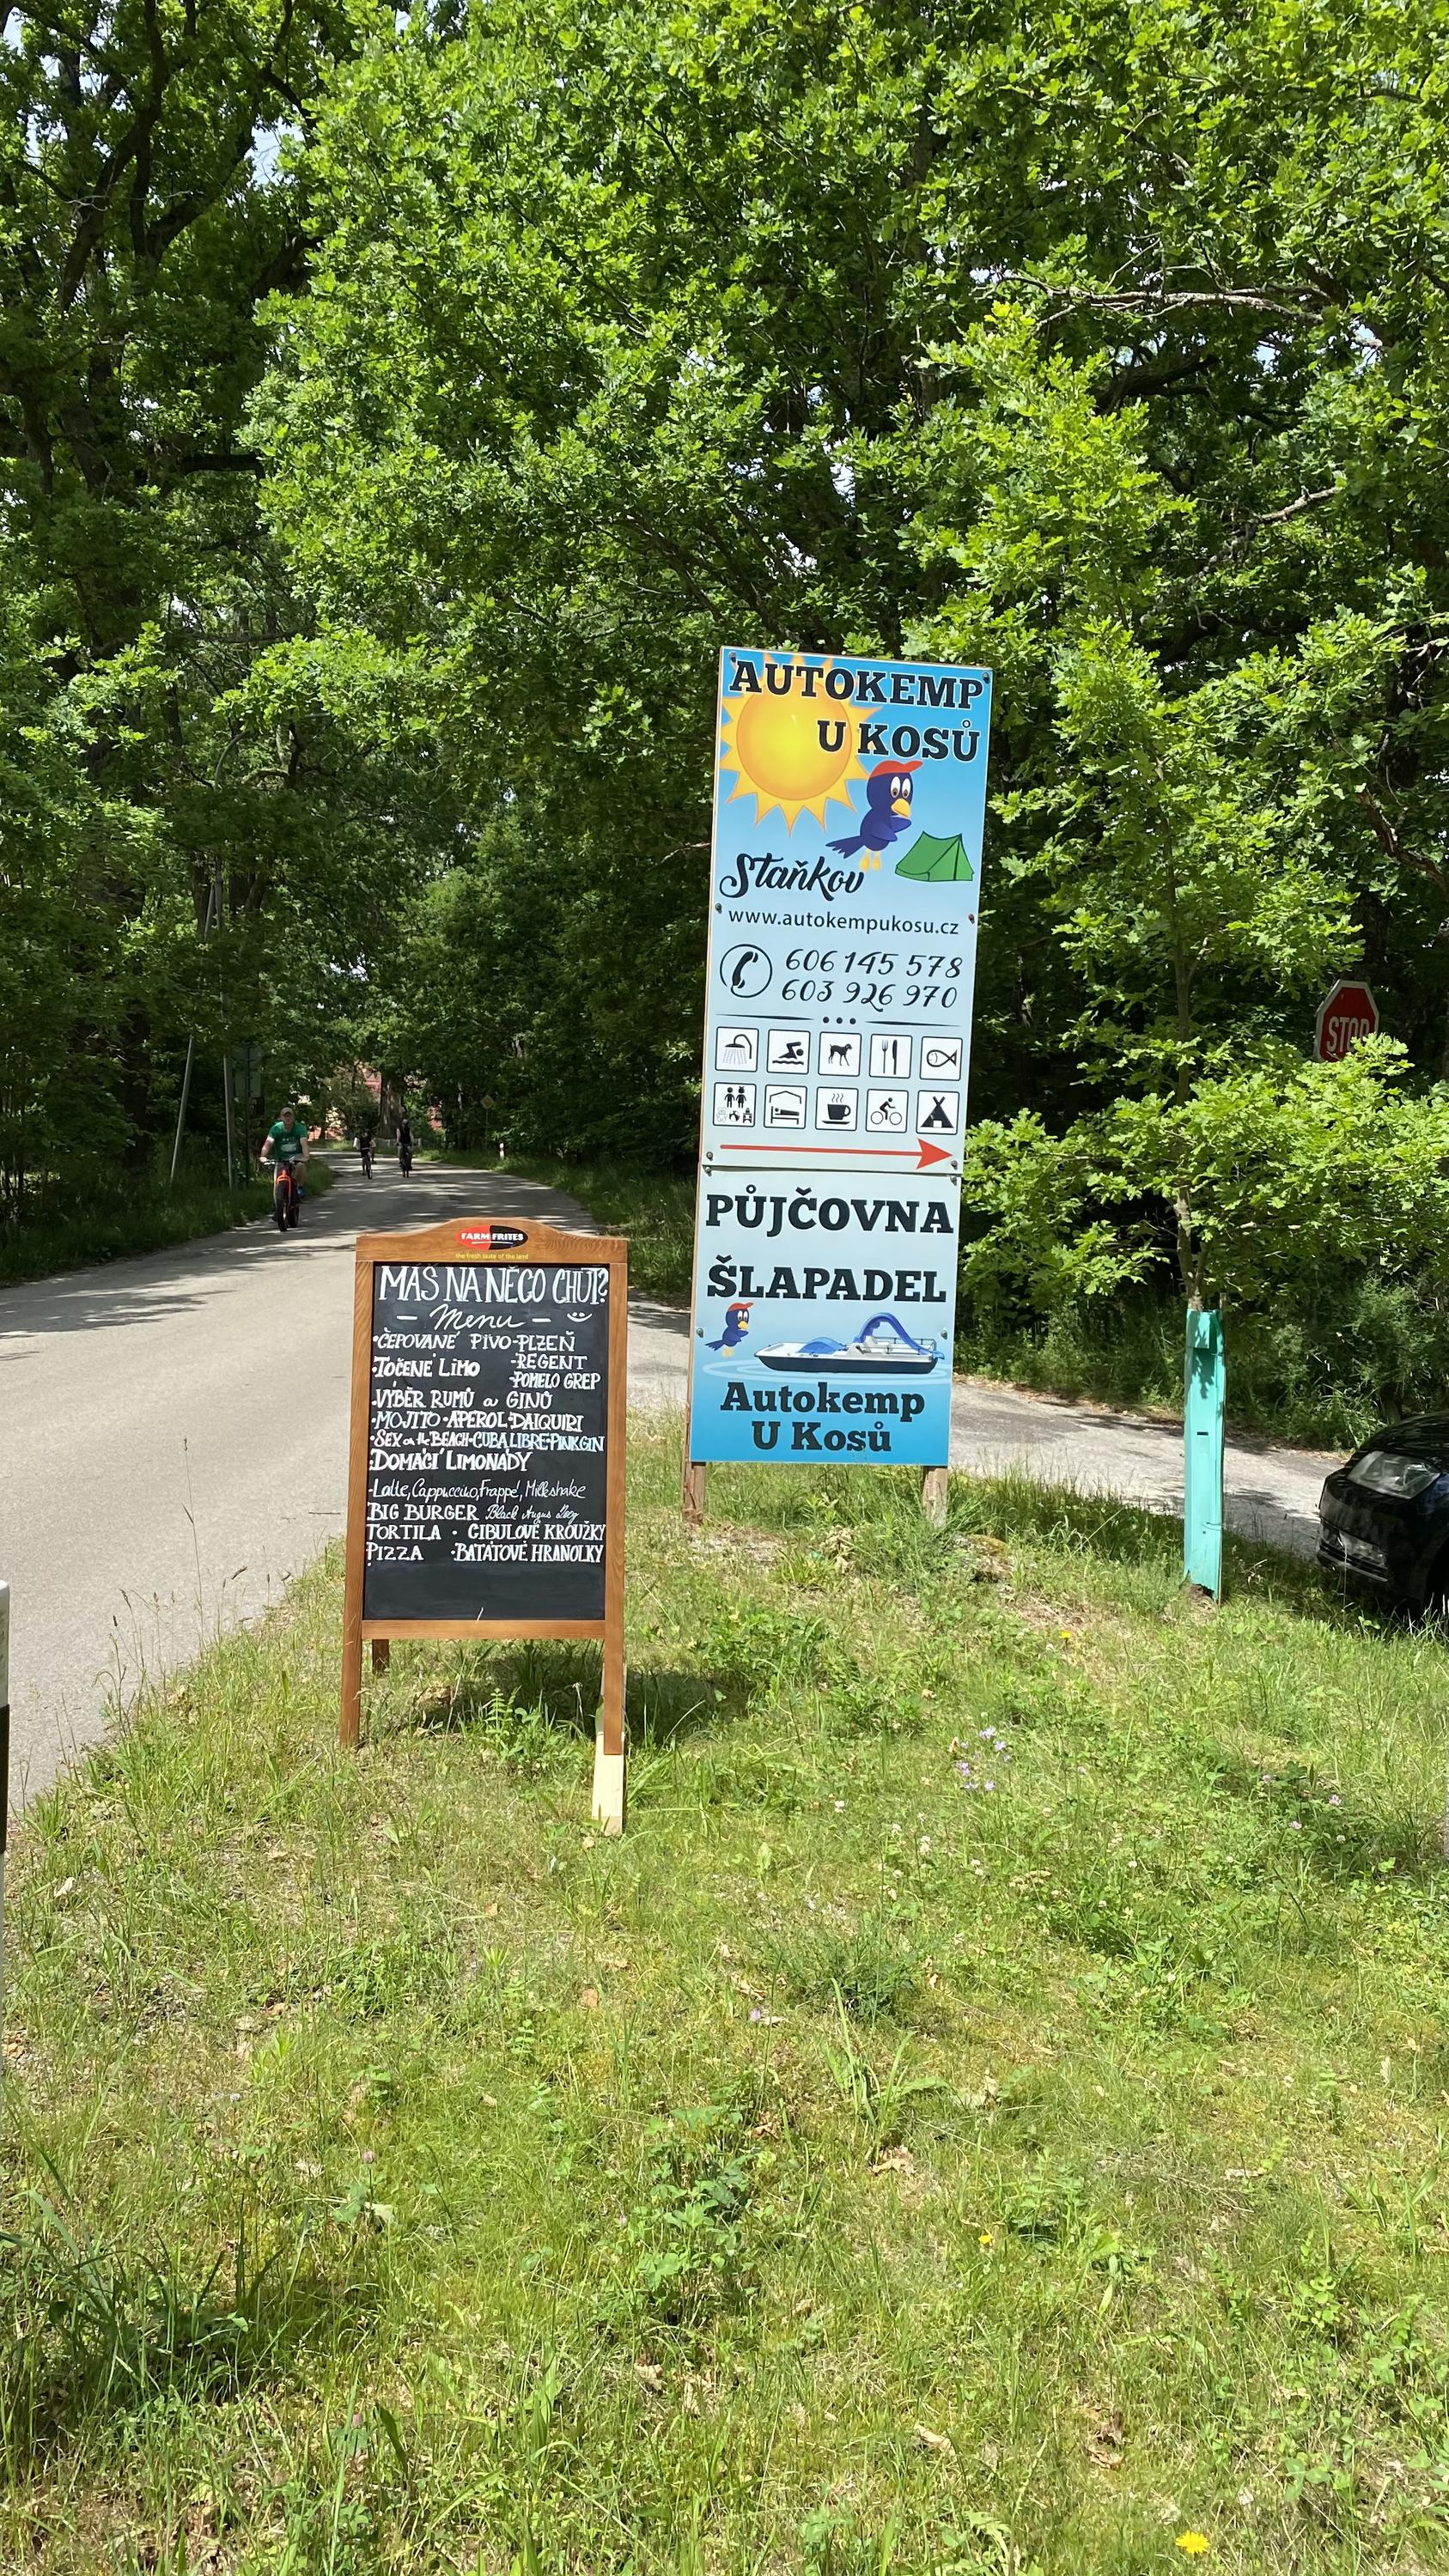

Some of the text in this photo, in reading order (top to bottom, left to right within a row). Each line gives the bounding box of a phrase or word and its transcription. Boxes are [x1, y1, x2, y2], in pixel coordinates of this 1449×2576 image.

[728, 659, 983, 710] AUTOKEMP
[817, 719, 980, 762] U KOSŮ
[719, 852, 865, 902] Staňkov
[728, 908, 959, 935] www.autokempukosu.cz
[785, 949, 964, 979] 606 145 578
[781, 979, 958, 1012] 603 926 970
[705, 1184, 954, 1237] PŮJČOVNA
[443, 1267, 483, 1303] NA
[707, 1255, 947, 1303] ŠLAPADEL
[429, 1303, 527, 1331] Menu
[378, 1327, 461, 1350] ČEPOVANÉ
[470, 1334, 512, 1350] PIVO
[376, 1381, 553, 1409] VÝBĚR RUMŮ a GINŮ
[563, 1373, 601, 1389] GREP
[720, 1382, 925, 1422] Autokemp
[374, 1410, 585, 1432] MOJITO APEROL DAIQUIRI
[429, 1431, 470, 1447] BEACH
[472, 1431, 509, 1449] CUBA
[510, 1432, 549, 1450] LIBRE
[550, 1432, 579, 1451] PINK
[579, 1436, 606, 1452] GIN
[752, 1421, 892, 1452] U Kosů
[369, 1448, 533, 1471] DOMÁCÍ LIMONÁDY
[479, 1479, 523, 1504] Frappé,
[525, 1479, 587, 1498] Milkshake
[367, 1501, 399, 1522] BIG
[404, 1504, 480, 1521] BURGER
[484, 1504, 520, 1521] Black
[521, 1505, 552, 1525] Angus
[366, 1520, 606, 1541] TORTILA CIBULOVÉ KROUŽKY
[366, 1540, 605, 1563] PIZZA BATÁTOVÉ HRANOLKY
